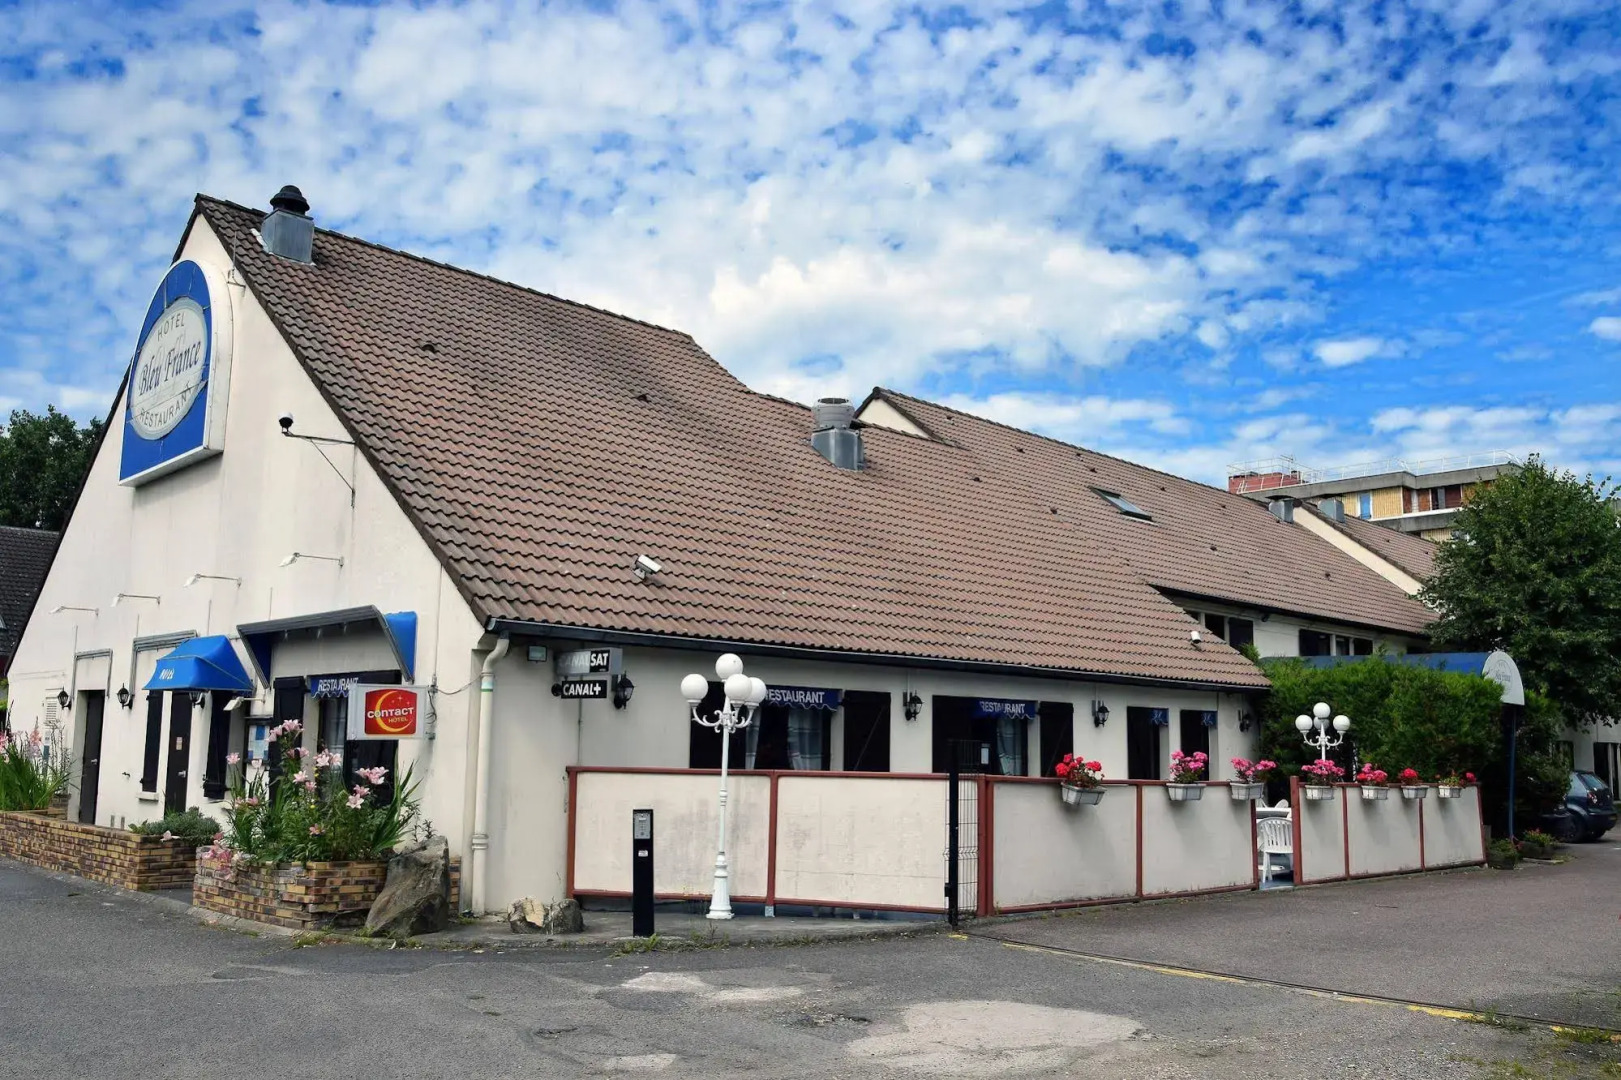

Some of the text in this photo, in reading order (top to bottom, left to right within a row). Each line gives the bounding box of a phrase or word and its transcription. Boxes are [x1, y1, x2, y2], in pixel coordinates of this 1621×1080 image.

[157, 312, 185, 342] HOTEL
[138, 340, 202, 397] Bleu France
[139, 381, 191, 427] RESTAURANT
[563, 683, 601, 695] CANAL+
[979, 701, 1026, 714] RESTAURANT
